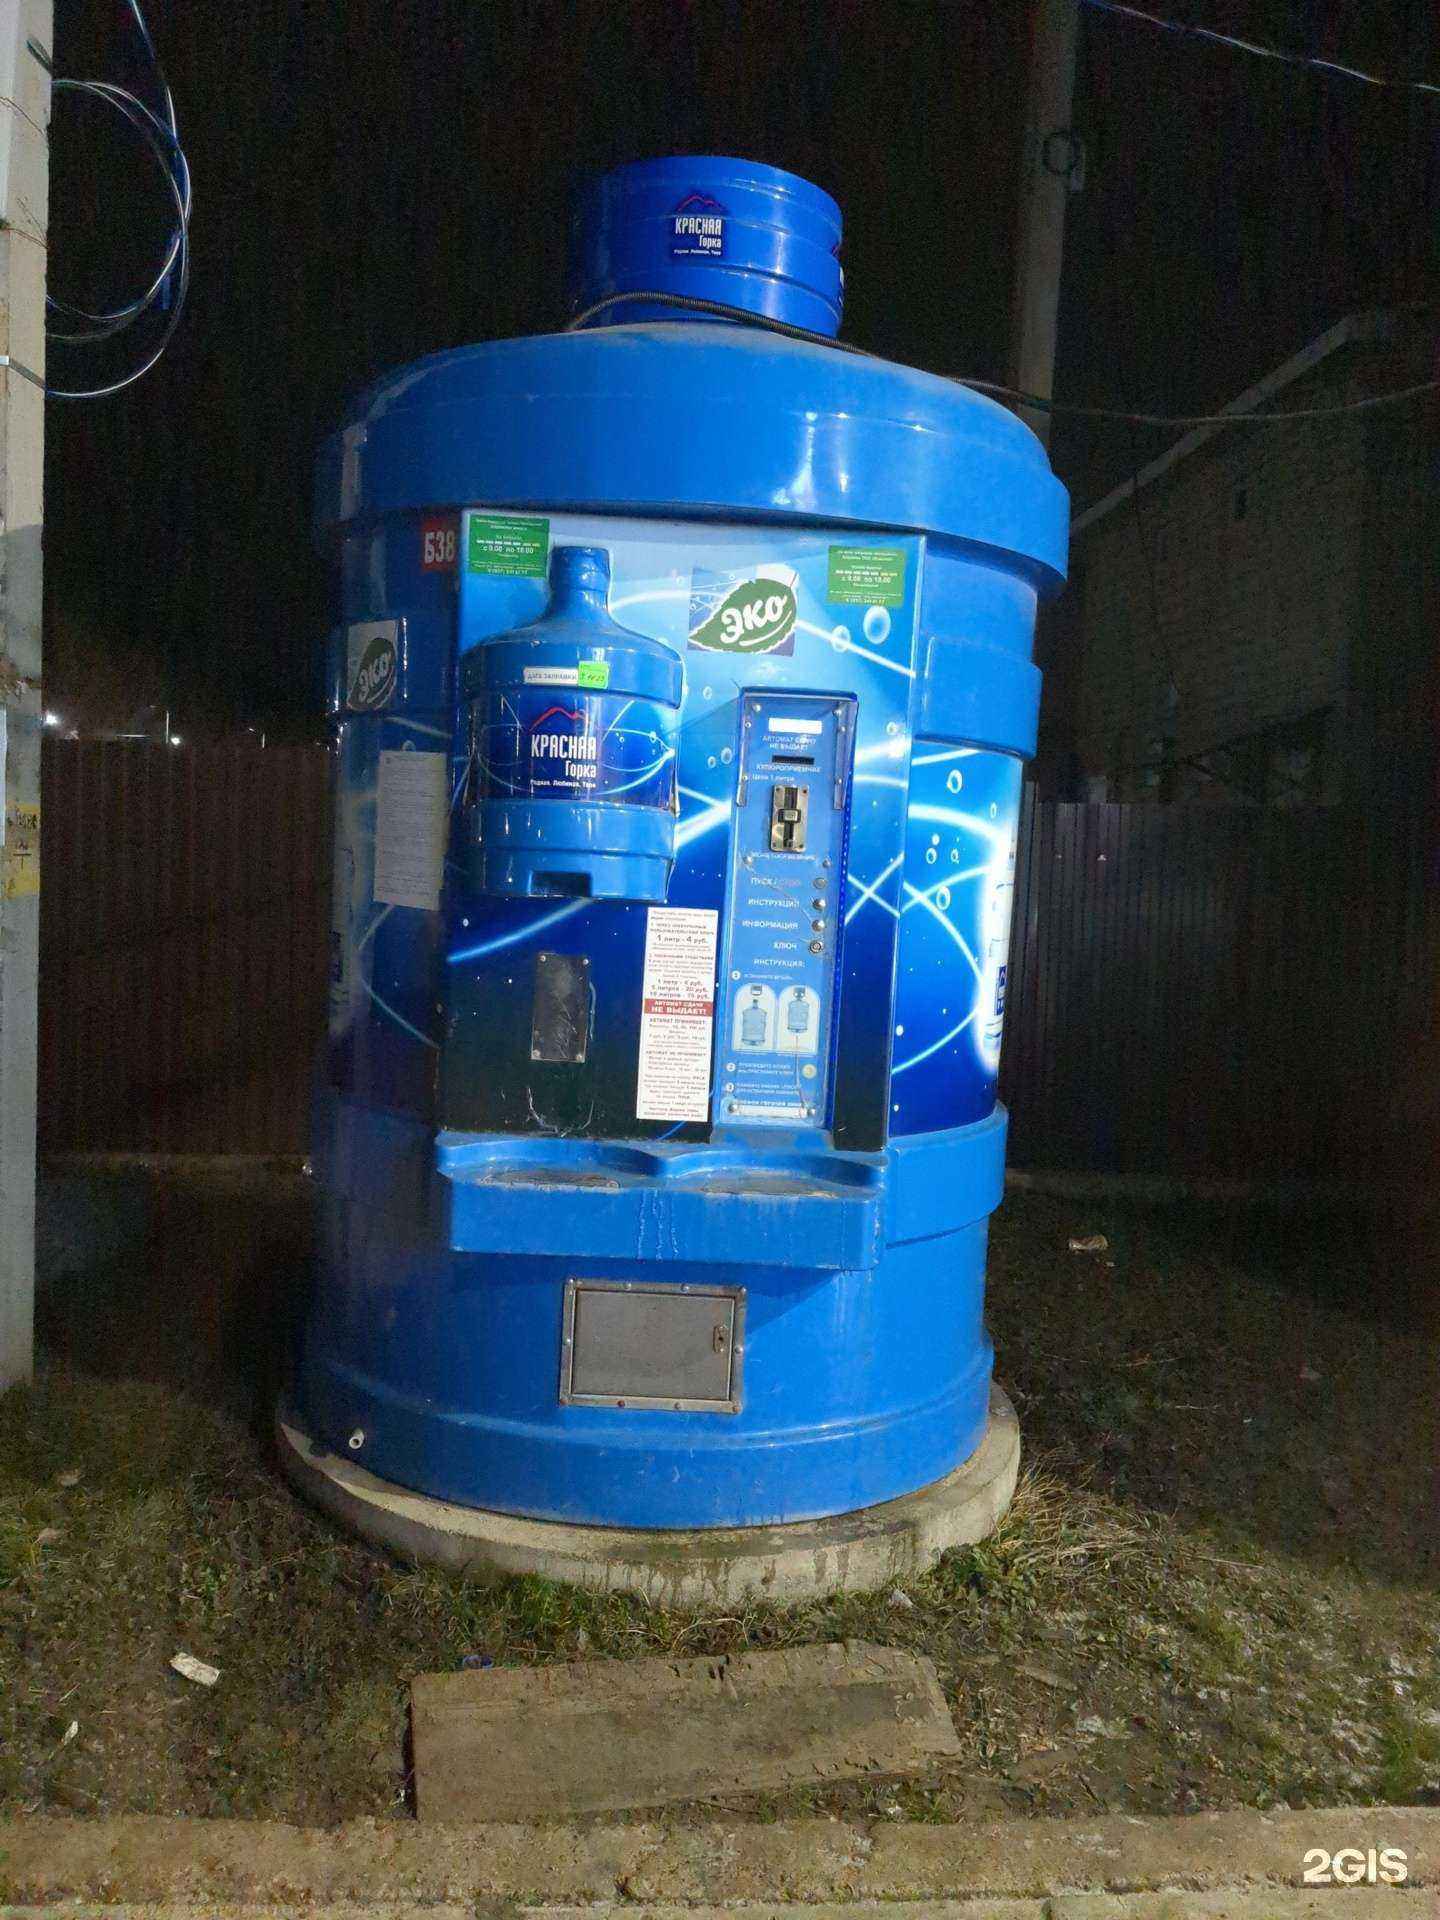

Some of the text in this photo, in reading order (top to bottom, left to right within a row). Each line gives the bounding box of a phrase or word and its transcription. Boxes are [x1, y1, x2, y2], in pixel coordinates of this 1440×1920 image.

[675, 217, 722, 236] КРАСНАЯ
[699, 234, 722, 249] Горка
[424, 531, 457, 564] Б38
[531, 734, 597, 760] КРАСНАЯ
[565, 760, 597, 779] Горка
